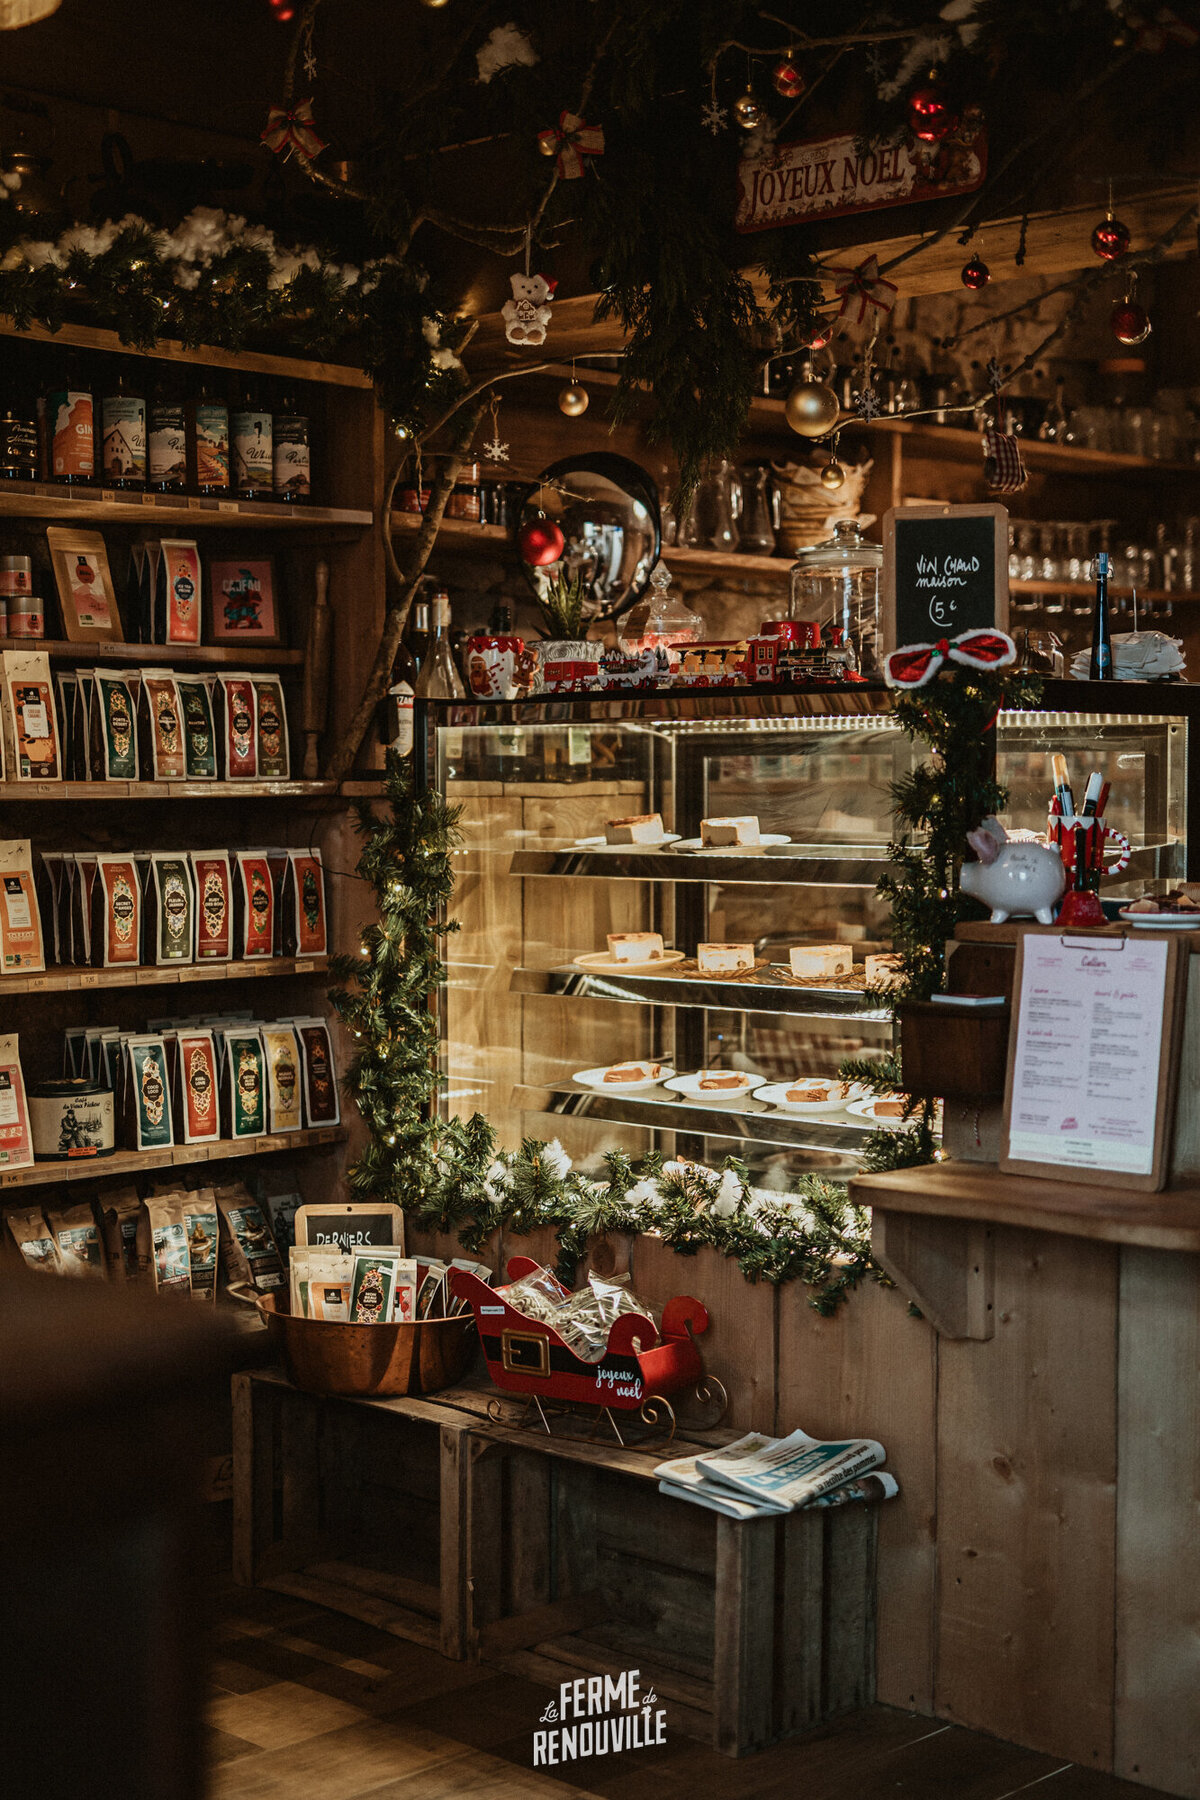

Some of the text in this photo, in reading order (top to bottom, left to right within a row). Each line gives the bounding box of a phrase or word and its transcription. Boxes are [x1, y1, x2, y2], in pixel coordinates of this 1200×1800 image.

[750, 160, 837, 220] JOYEUX
[944, 555, 980, 576] CHAUD
[916, 574, 967, 588] maison
[596, 1365, 634, 1389] joyeux
[616, 1379, 642, 1400] noël
[853, 1454, 877, 1475] pommes
